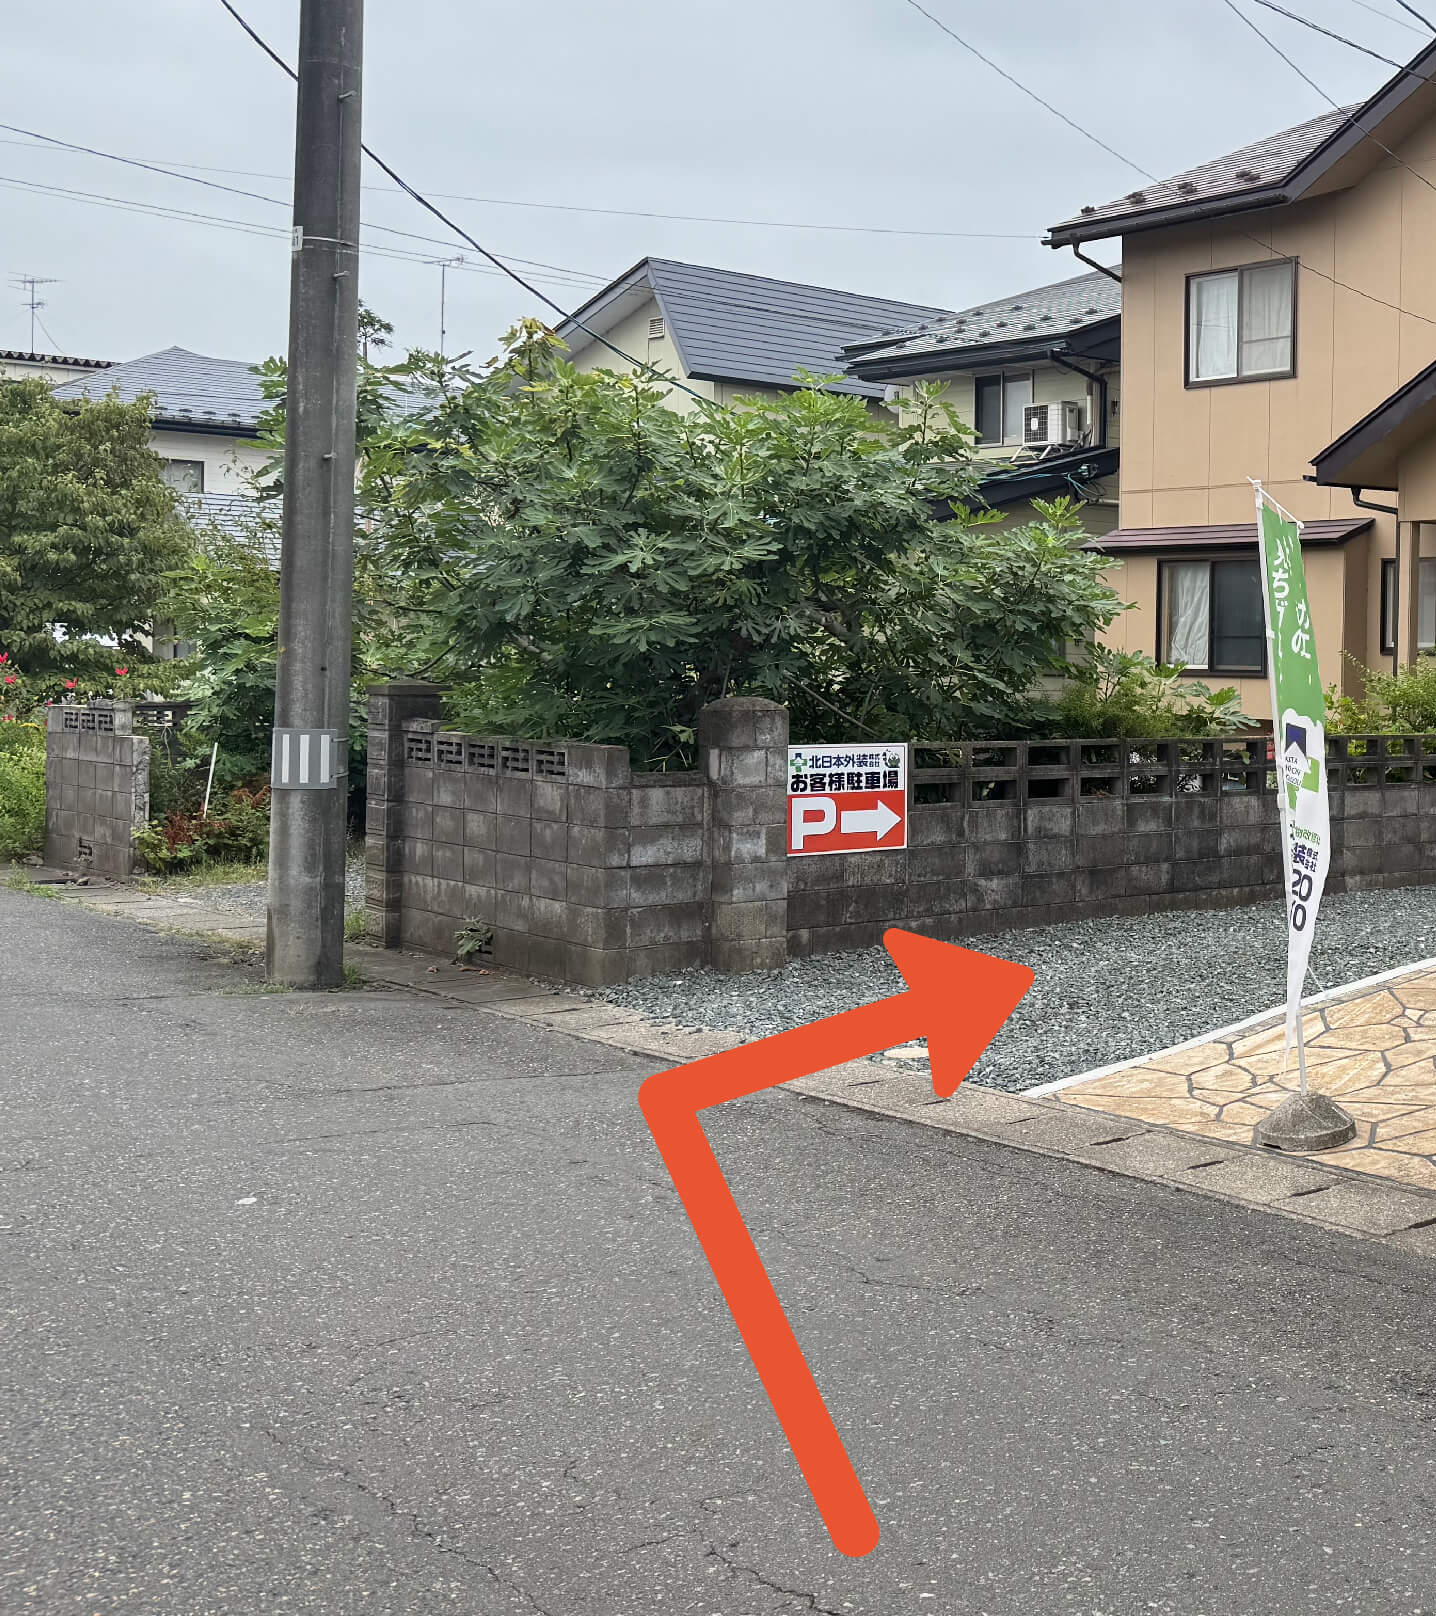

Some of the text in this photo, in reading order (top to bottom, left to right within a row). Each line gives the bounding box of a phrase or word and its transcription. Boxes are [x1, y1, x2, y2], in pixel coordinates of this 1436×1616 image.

[790, 770, 899, 793] お客様駐車場
[791, 796, 837, 850] P
